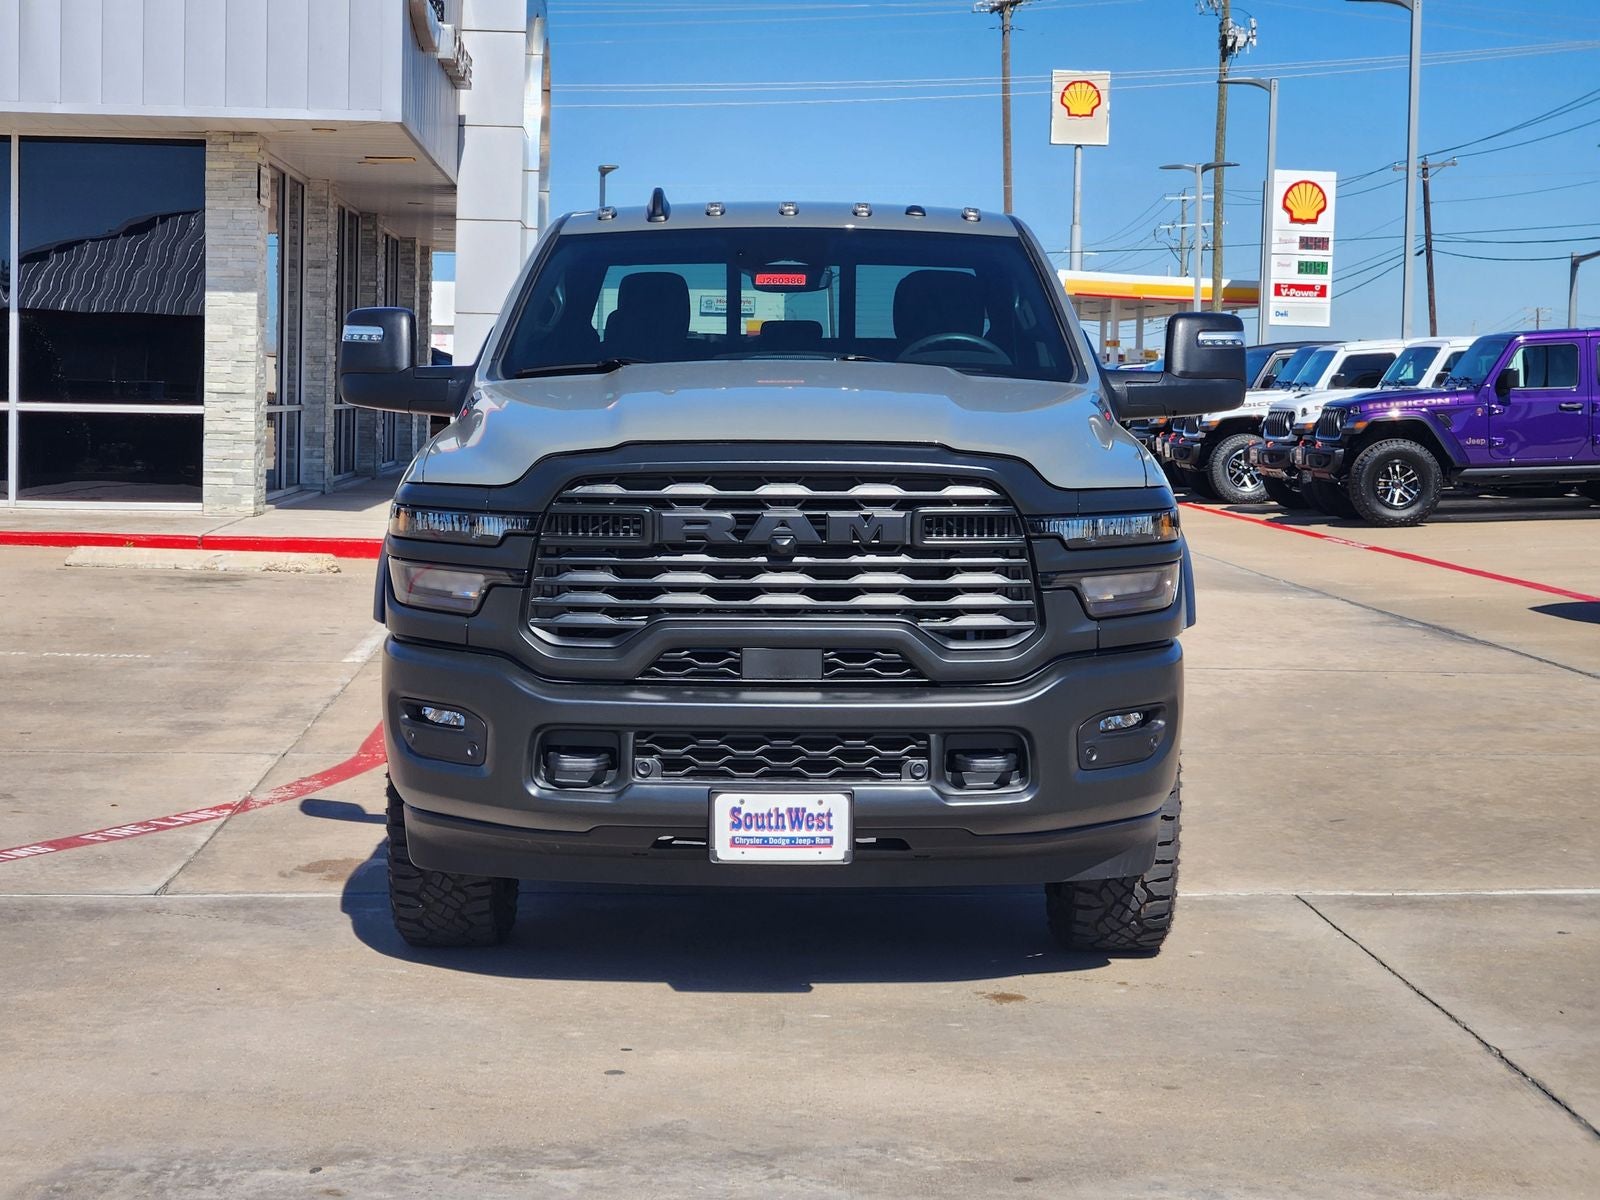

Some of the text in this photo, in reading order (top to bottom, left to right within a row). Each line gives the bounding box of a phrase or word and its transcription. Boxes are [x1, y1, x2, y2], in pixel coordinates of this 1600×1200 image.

[1280, 287, 1319, 297] V-Power
[1368, 398, 1450, 410] RUBICON
[1465, 437, 1486, 445] Jeep
[660, 511, 906, 545] RAM
[729, 806, 834, 832] SouthWest
[0, 809, 233, 861] ING FIRE LANE
[734, 836, 831, 846] Chrysler Dodge Jeep Ram
